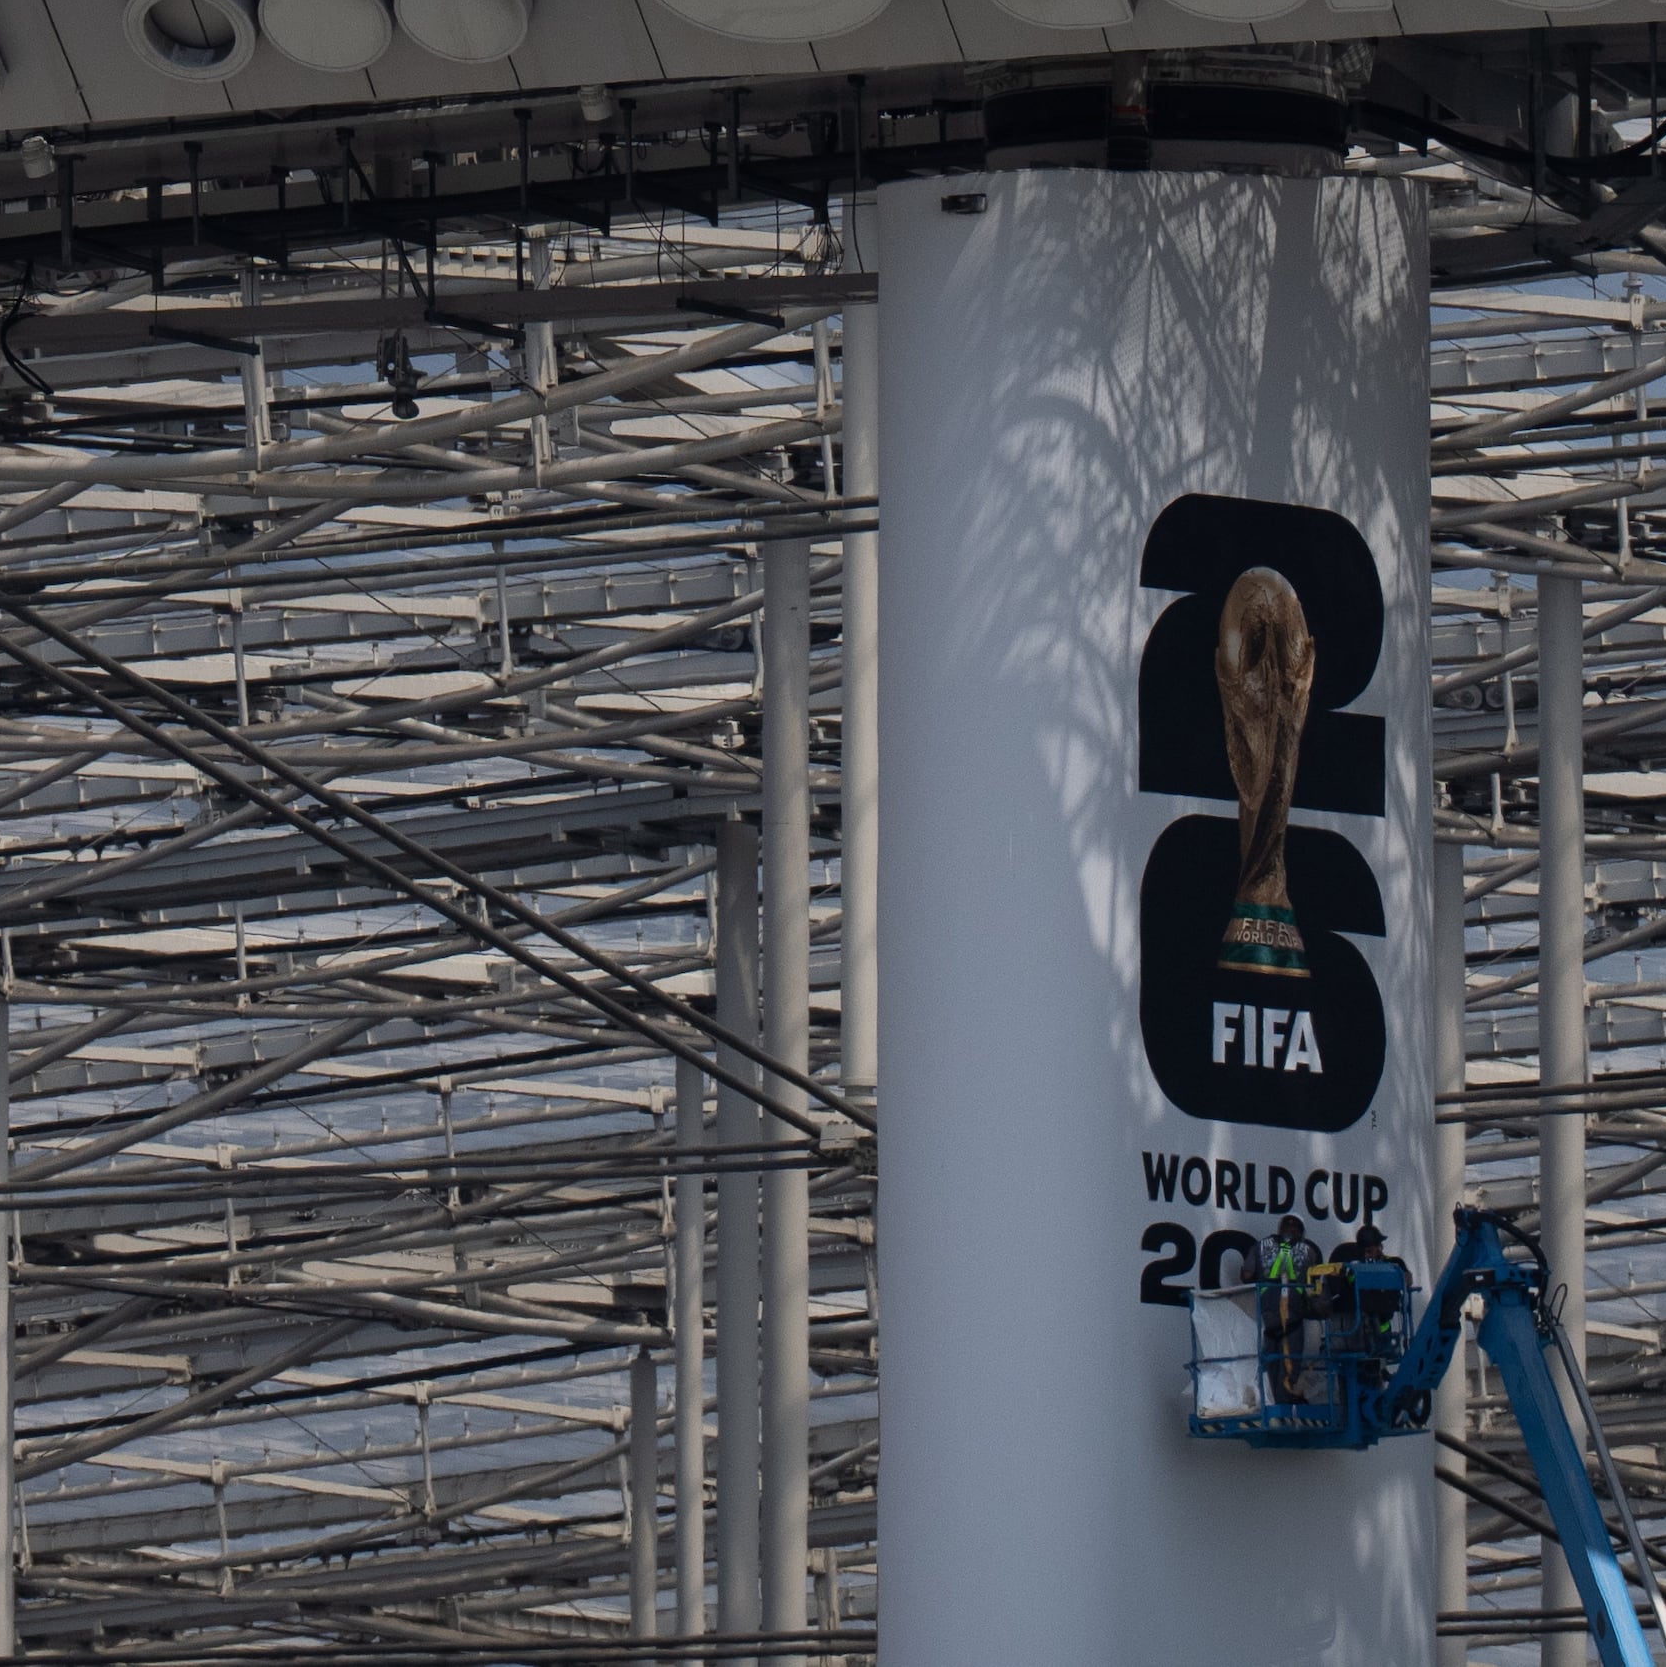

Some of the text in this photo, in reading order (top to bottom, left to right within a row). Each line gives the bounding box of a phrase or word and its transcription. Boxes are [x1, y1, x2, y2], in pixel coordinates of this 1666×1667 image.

[1242, 918, 1289, 933] FIFA
[1212, 1001, 1323, 1074] FIFA
[1142, 1151, 1388, 1226] WORLD CUP
